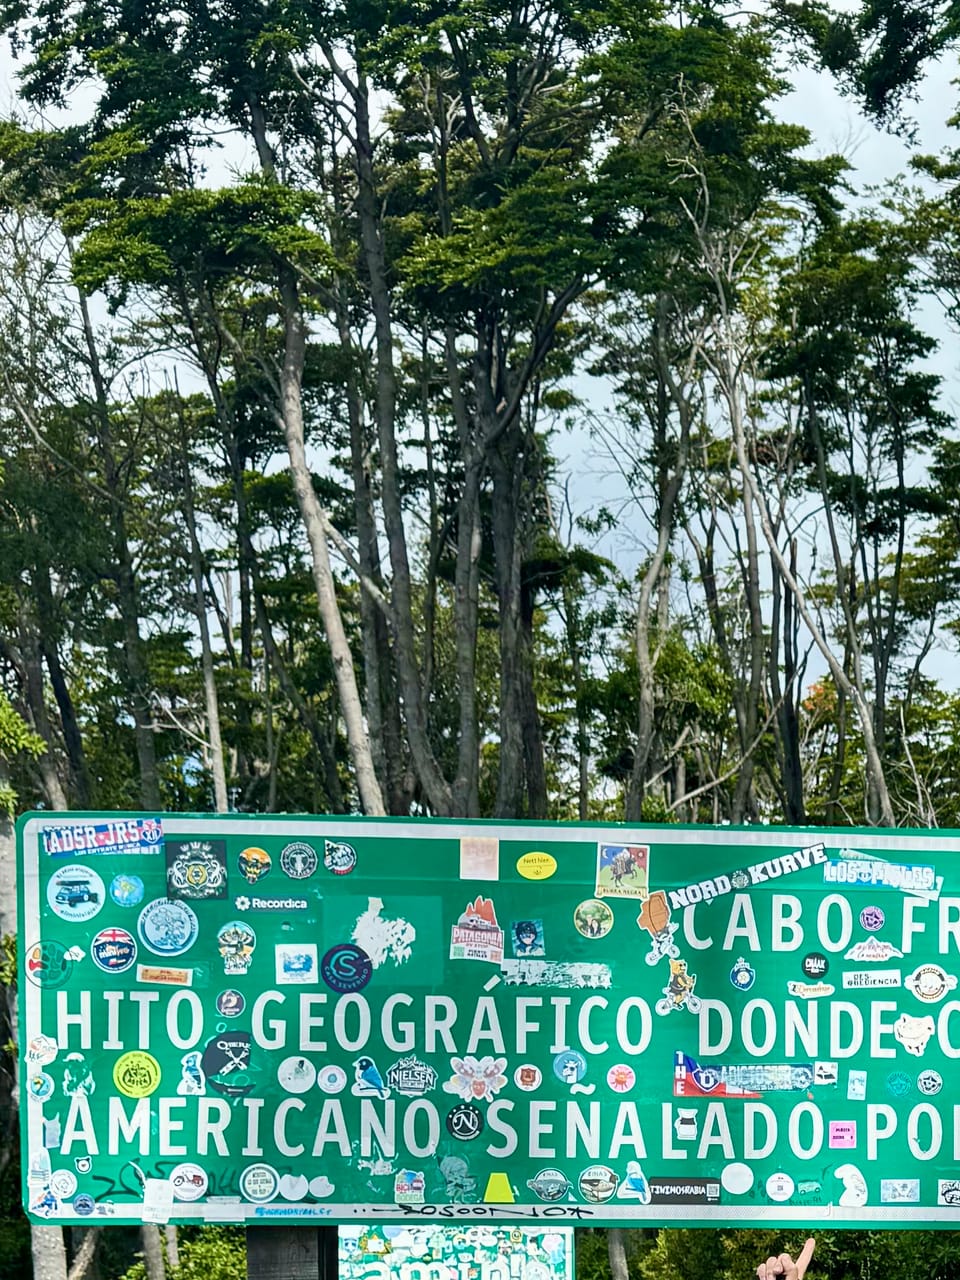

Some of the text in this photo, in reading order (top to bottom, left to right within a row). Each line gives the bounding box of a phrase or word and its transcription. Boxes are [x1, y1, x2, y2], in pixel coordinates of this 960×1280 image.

[669, 842, 829, 910] NORD KURVE
[452, 927, 504, 949] PATAGONIA
[682, 892, 852, 953] CABO
[56, 989, 205, 1050] HITO
[251, 975, 653, 1056] GEOGRÁFICO
[698, 996, 897, 1059] DONDE
[390, 1070, 434, 1086] NIELSEN
[59, 1096, 441, 1158] AMERICANO
[486, 1083, 824, 1161] SEÑALADO
